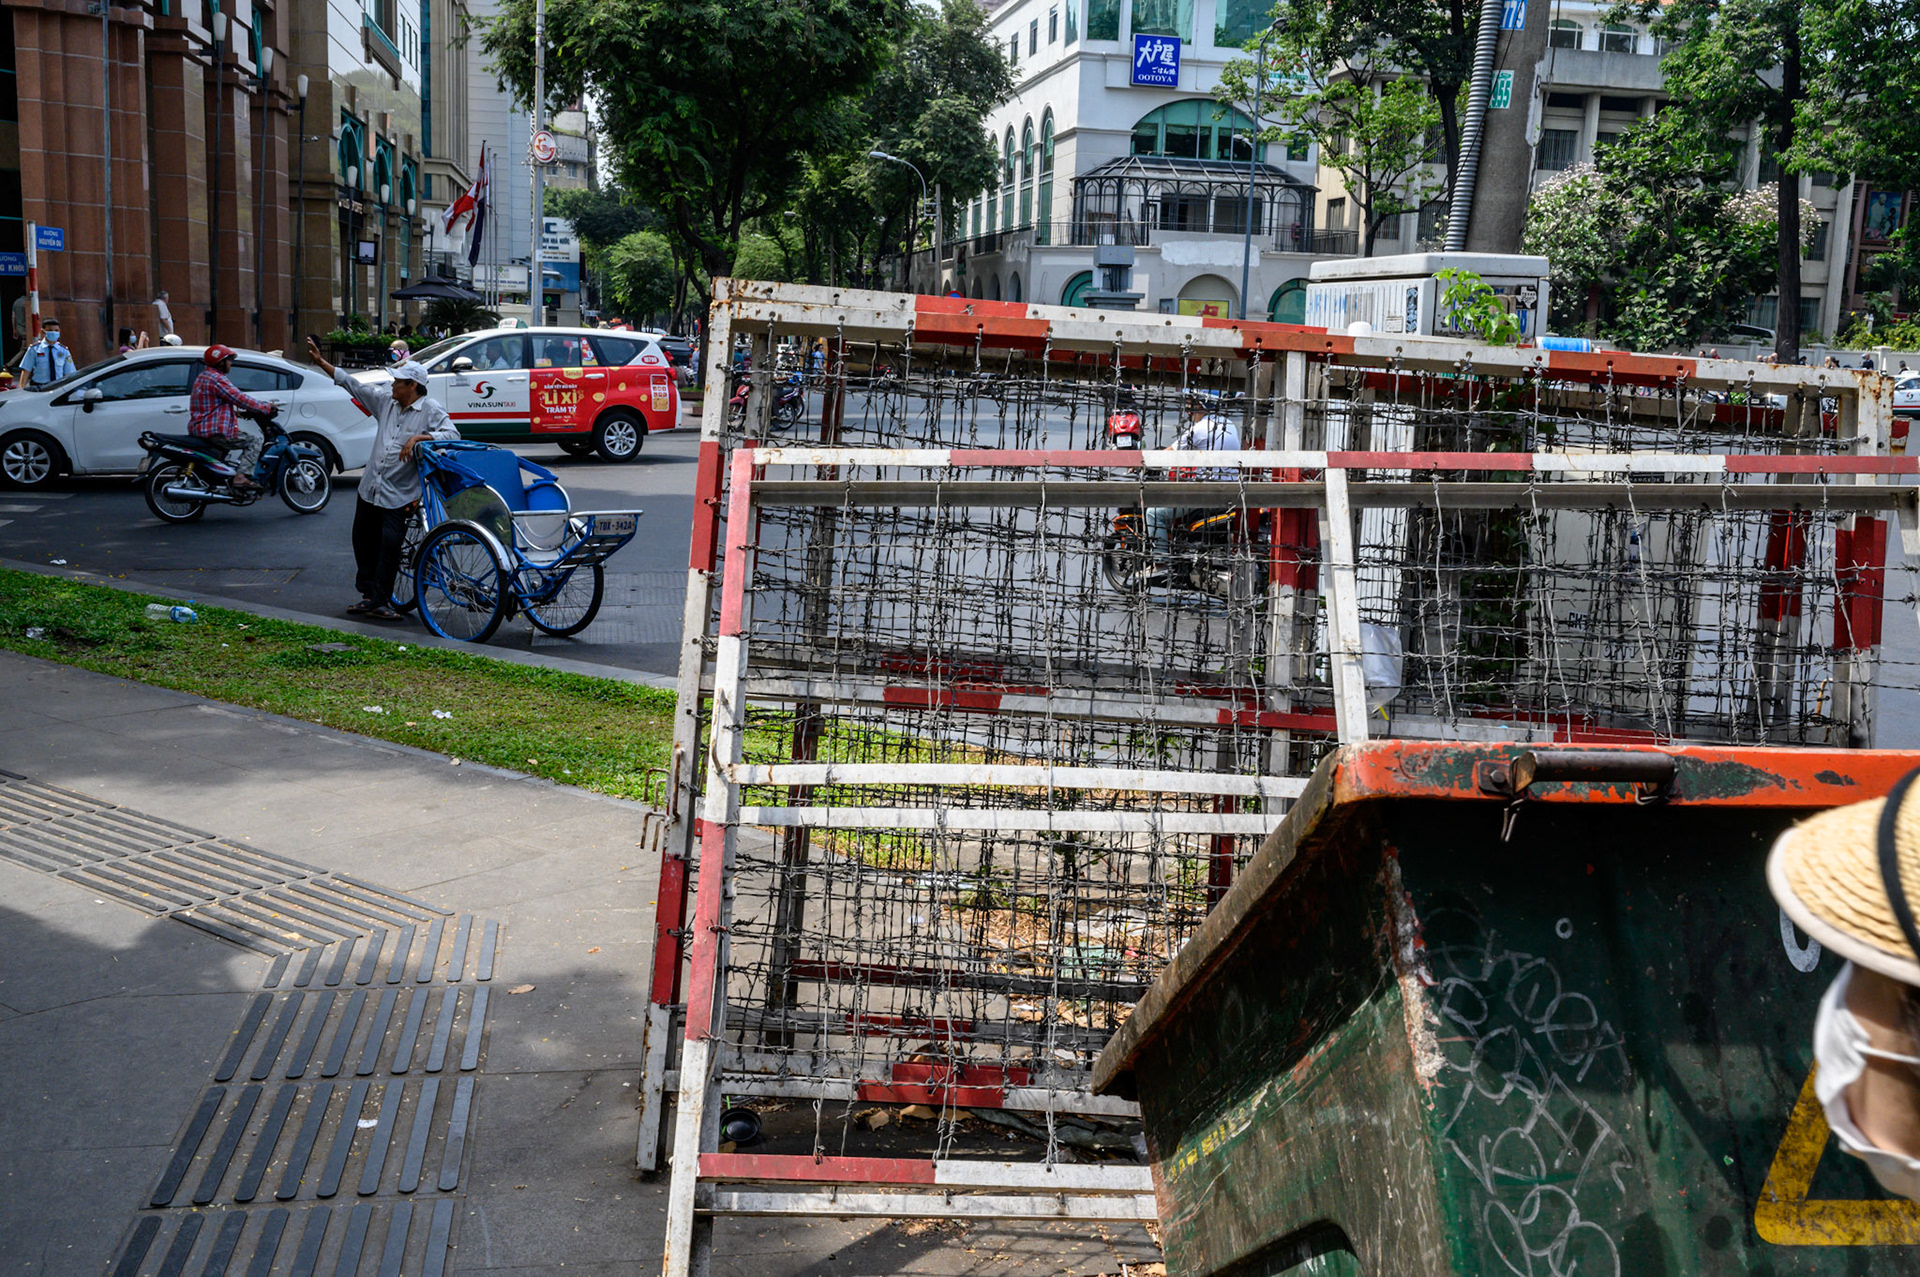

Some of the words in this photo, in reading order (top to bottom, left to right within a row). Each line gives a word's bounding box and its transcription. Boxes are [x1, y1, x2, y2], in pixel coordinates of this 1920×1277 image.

[1138, 74, 1173, 83] OOTOYA
[544, 389, 558, 405] LÌ
[561, 389, 577, 405] XÌ
